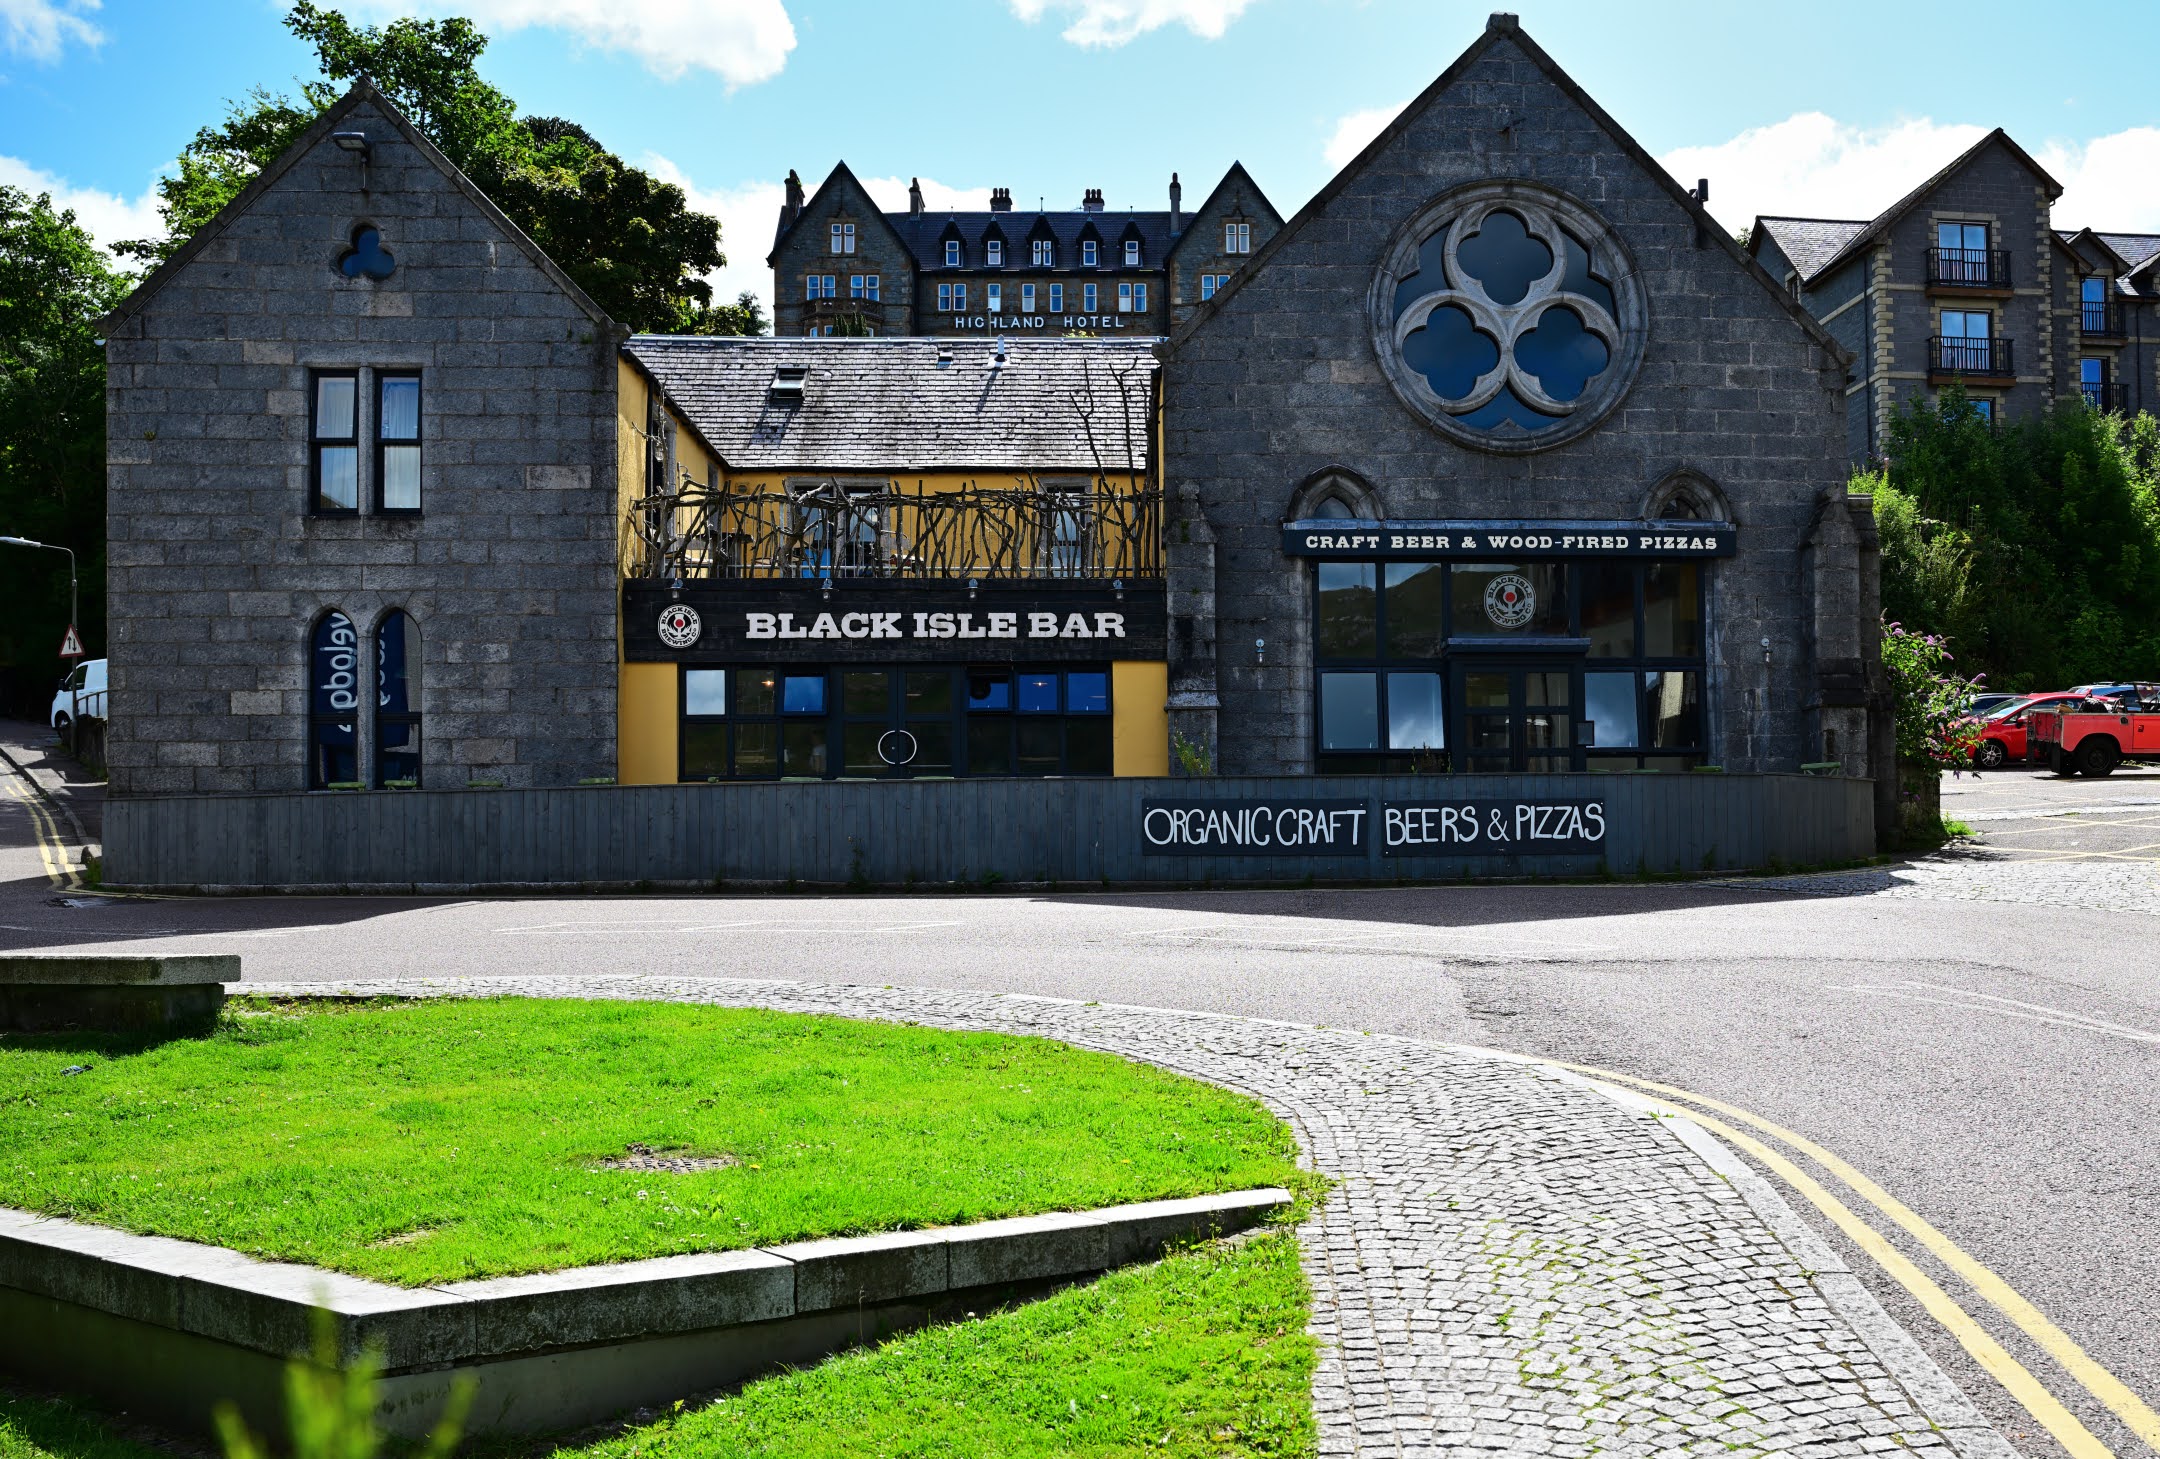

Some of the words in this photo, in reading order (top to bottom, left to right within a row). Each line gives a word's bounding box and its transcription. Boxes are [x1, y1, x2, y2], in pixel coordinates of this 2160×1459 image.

[955, 316, 1044, 328] HIGHLAND
[1064, 316, 1125, 328] HOTEL
[1305, 535, 1380, 549] CRAFT
[1390, 535, 1450, 549] BEER
[1461, 536, 1477, 549] &
[1487, 535, 1630, 549] WOOD-FIRED
[1639, 535, 1718, 550] PIZZAS
[1488, 576, 1515, 599] BLACK
[1515, 578, 1533, 599] ISLE
[661, 607, 683, 624] BLACK
[684, 609, 698, 624] ISLE
[1488, 603, 1527, 625] BREWING
[745, 612, 903, 639] BLACK
[912, 612, 1018, 639] ISLE
[1027, 612, 1126, 639] BAR
[661, 629, 692, 645] BREWING
[1143, 806, 1272, 846] ORGANIC
[1275, 808, 1367, 846] CRAFT
[1385, 805, 1479, 846] BEERS
[1487, 808, 1511, 842] &
[1515, 803, 1606, 841] PIZZAS
